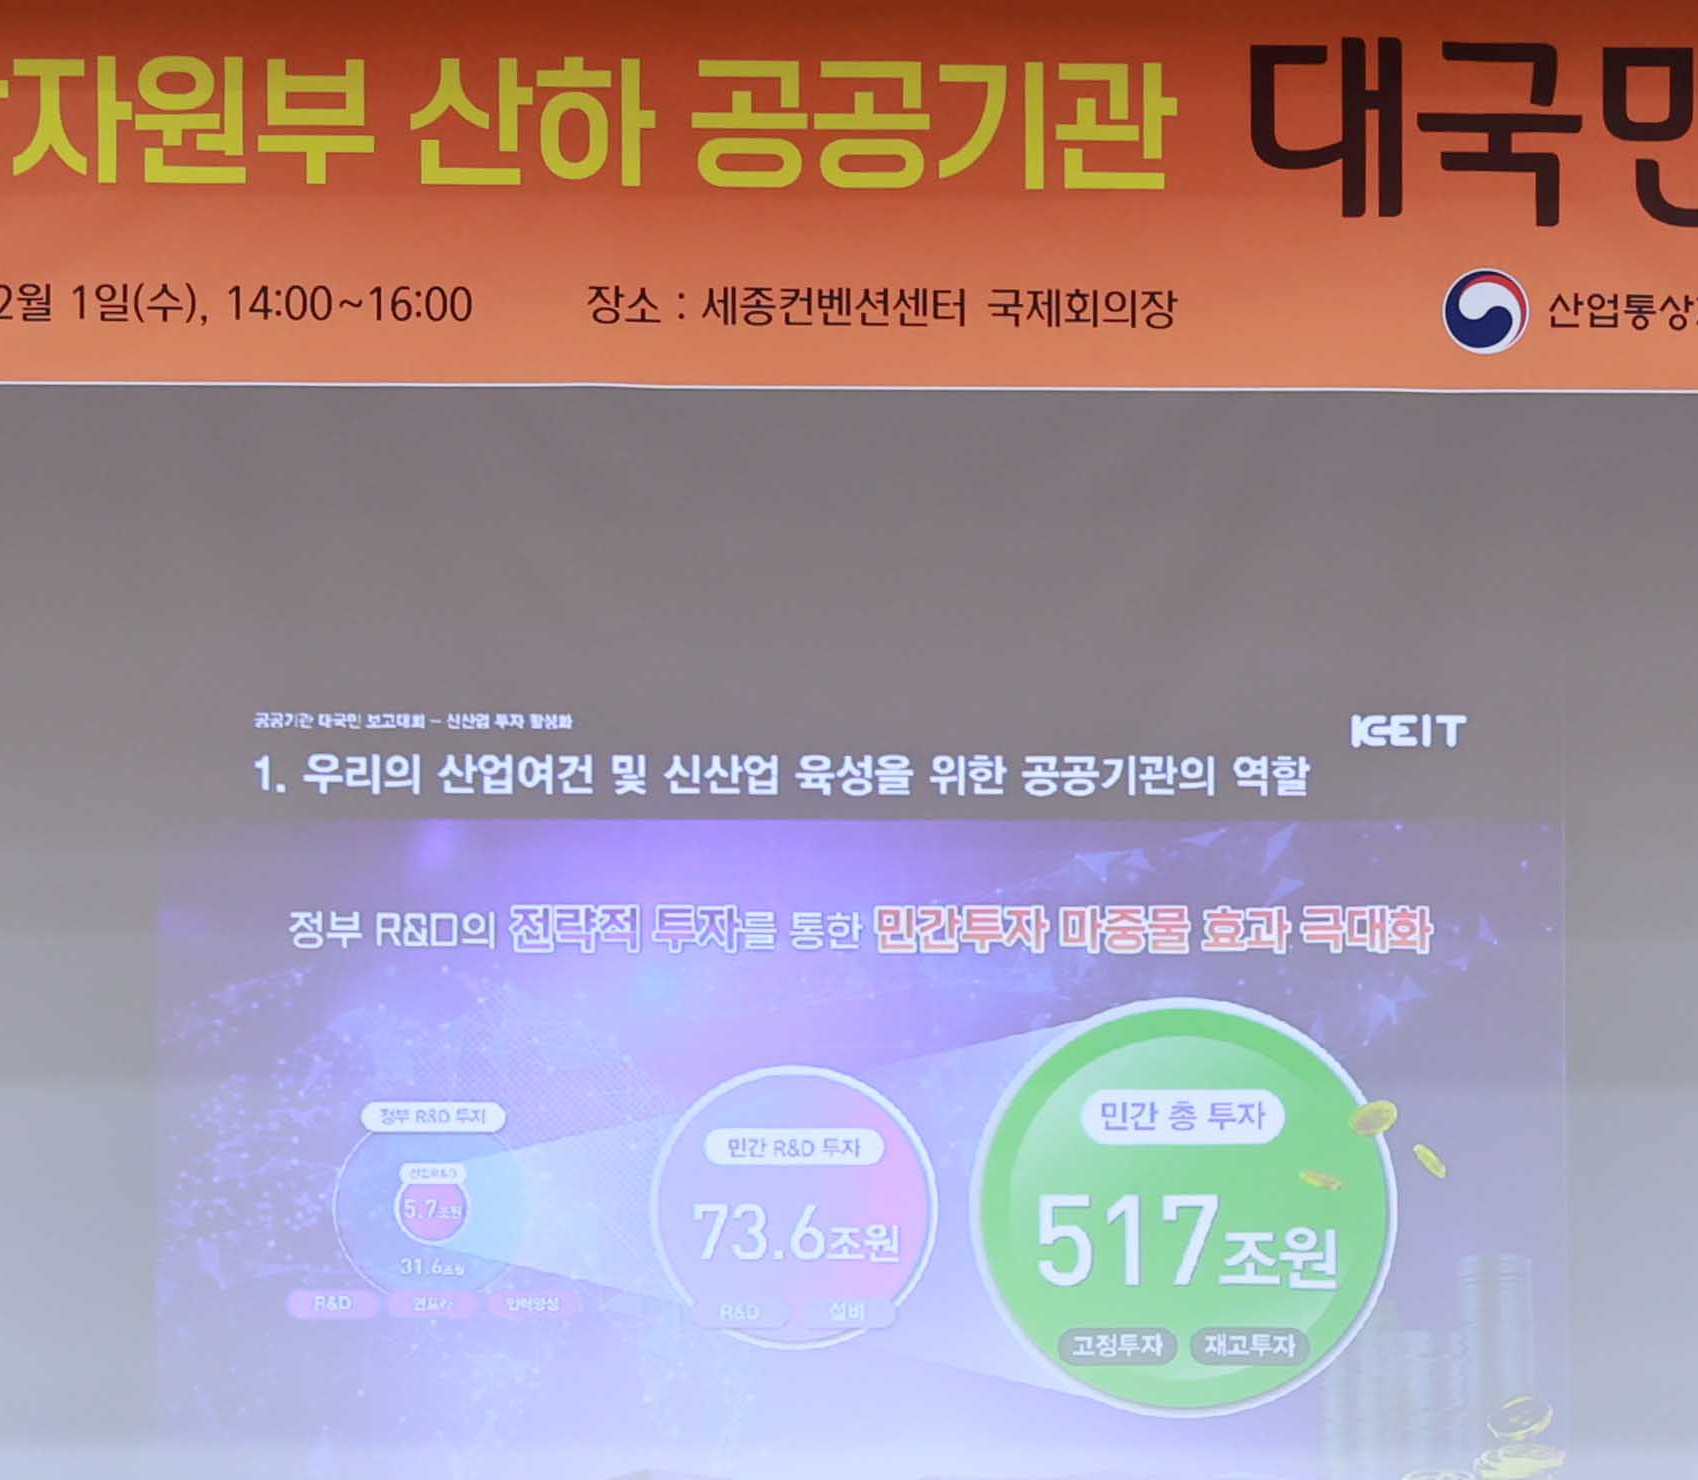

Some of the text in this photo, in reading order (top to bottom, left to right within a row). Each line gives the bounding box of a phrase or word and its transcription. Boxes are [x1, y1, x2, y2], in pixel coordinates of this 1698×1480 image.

[410, 56, 656, 188] 산하
[692, 59, 1178, 190] 공공기관
[72, 283, 208, 328] 1일(수),
[227, 286, 473, 325] 14:00~16:00
[587, 285, 662, 327] 장소
[701, 285, 967, 329] 세종컨벤션센터
[988, 286, 1179, 331] 국제회의장
[253, 712, 314, 730] 공공기관
[254, 754, 1311, 796] 1. 우리의 산업여건 및 신산업 육성을 위한 공공기관의 역할
[288, 910, 363, 950] 정부
[508, 904, 641, 953] 전략적
[651, 904, 778, 953] 투자를
[789, 910, 862, 950] 통한
[873, 905, 1049, 954] 민간투자
[1059, 905, 1191, 954] 마중물
[1201, 905, 1291, 954] 효과
[1300, 905, 1435, 954] 극대화
[1101, 1102, 1266, 1131] 민간 총 투자
[728, 1138, 861, 1158] 민간 R&D 투자
[693, 1203, 902, 1263] 73.6조원
[1036, 1193, 1340, 1290] 517조원
[1071, 1334, 1164, 1359] 고정투자
[1204, 1333, 1297, 1359] 재고투자
